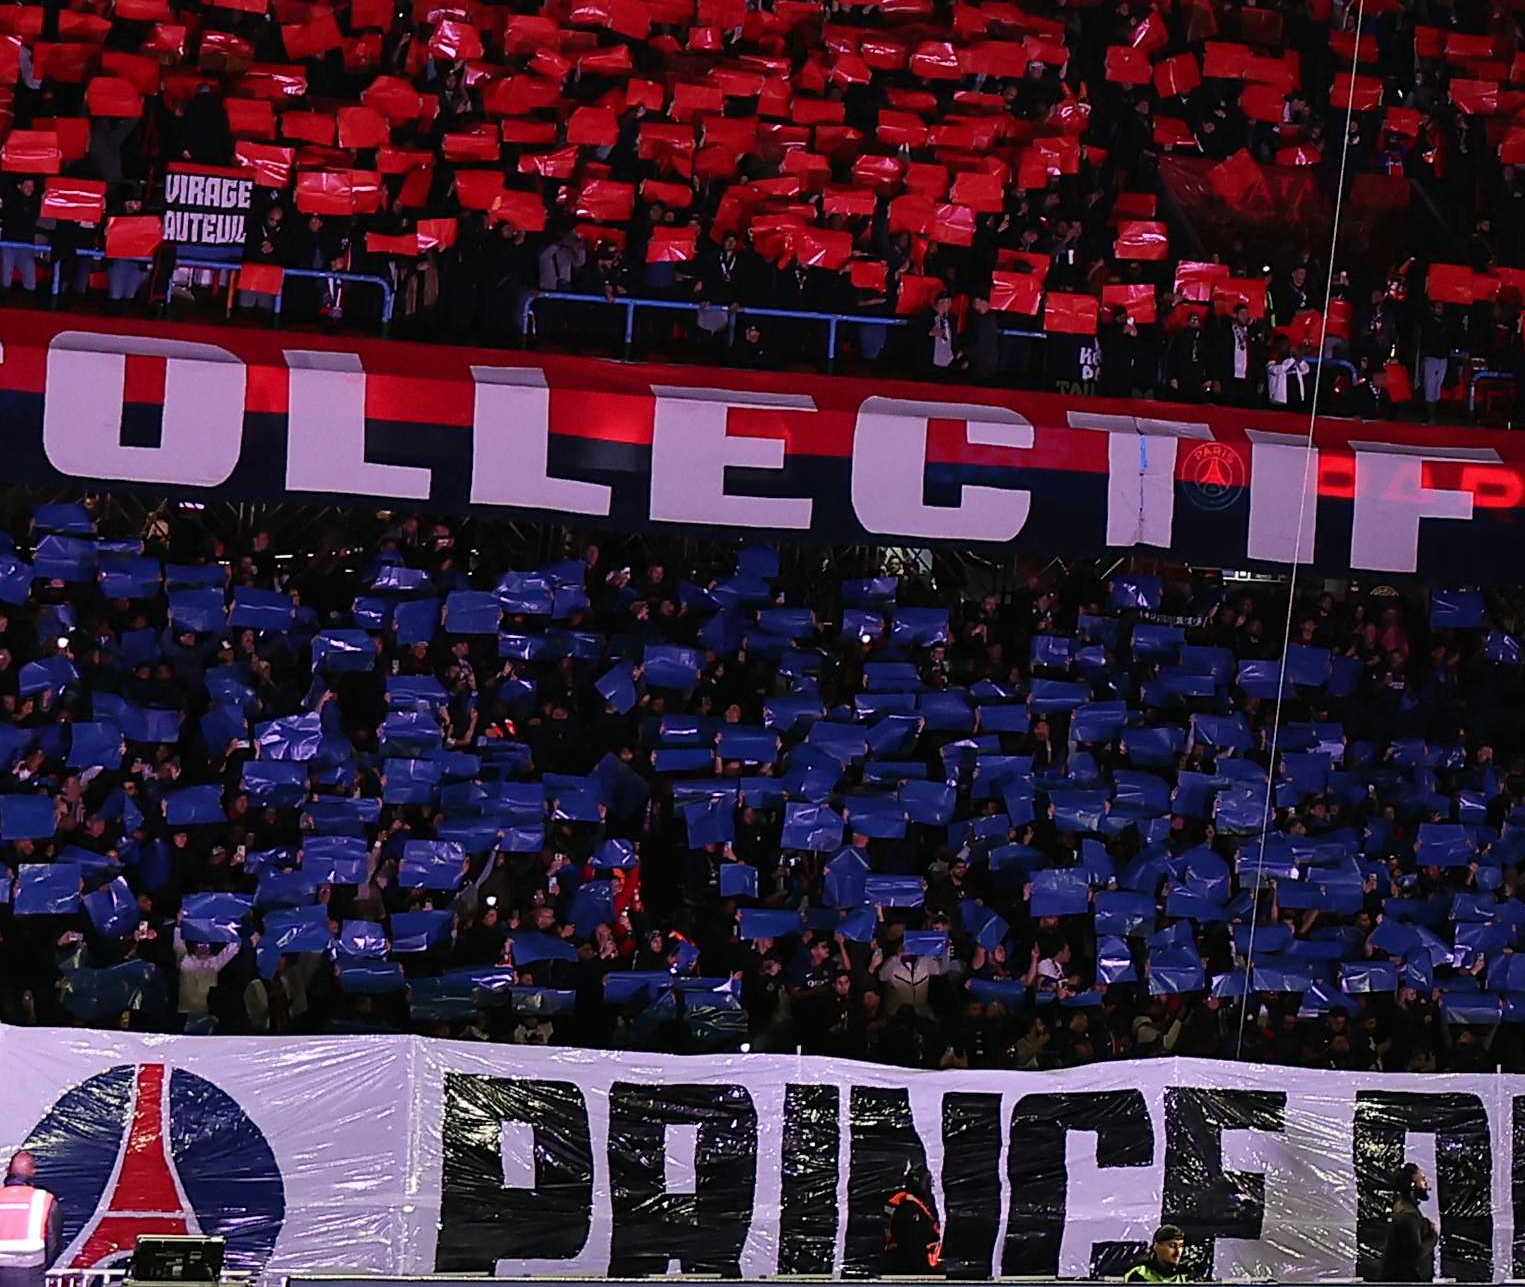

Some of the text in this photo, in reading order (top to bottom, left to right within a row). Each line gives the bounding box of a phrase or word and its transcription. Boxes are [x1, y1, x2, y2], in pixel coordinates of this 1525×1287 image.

[163, 173, 254, 210] VIRAGE
[161, 209, 248, 245] AUTEUIL
[0, 329, 1504, 574] OLLECTIF
[1194, 445, 1236, 465] PARIS
[435, 1072, 1288, 1281] PRINCE
